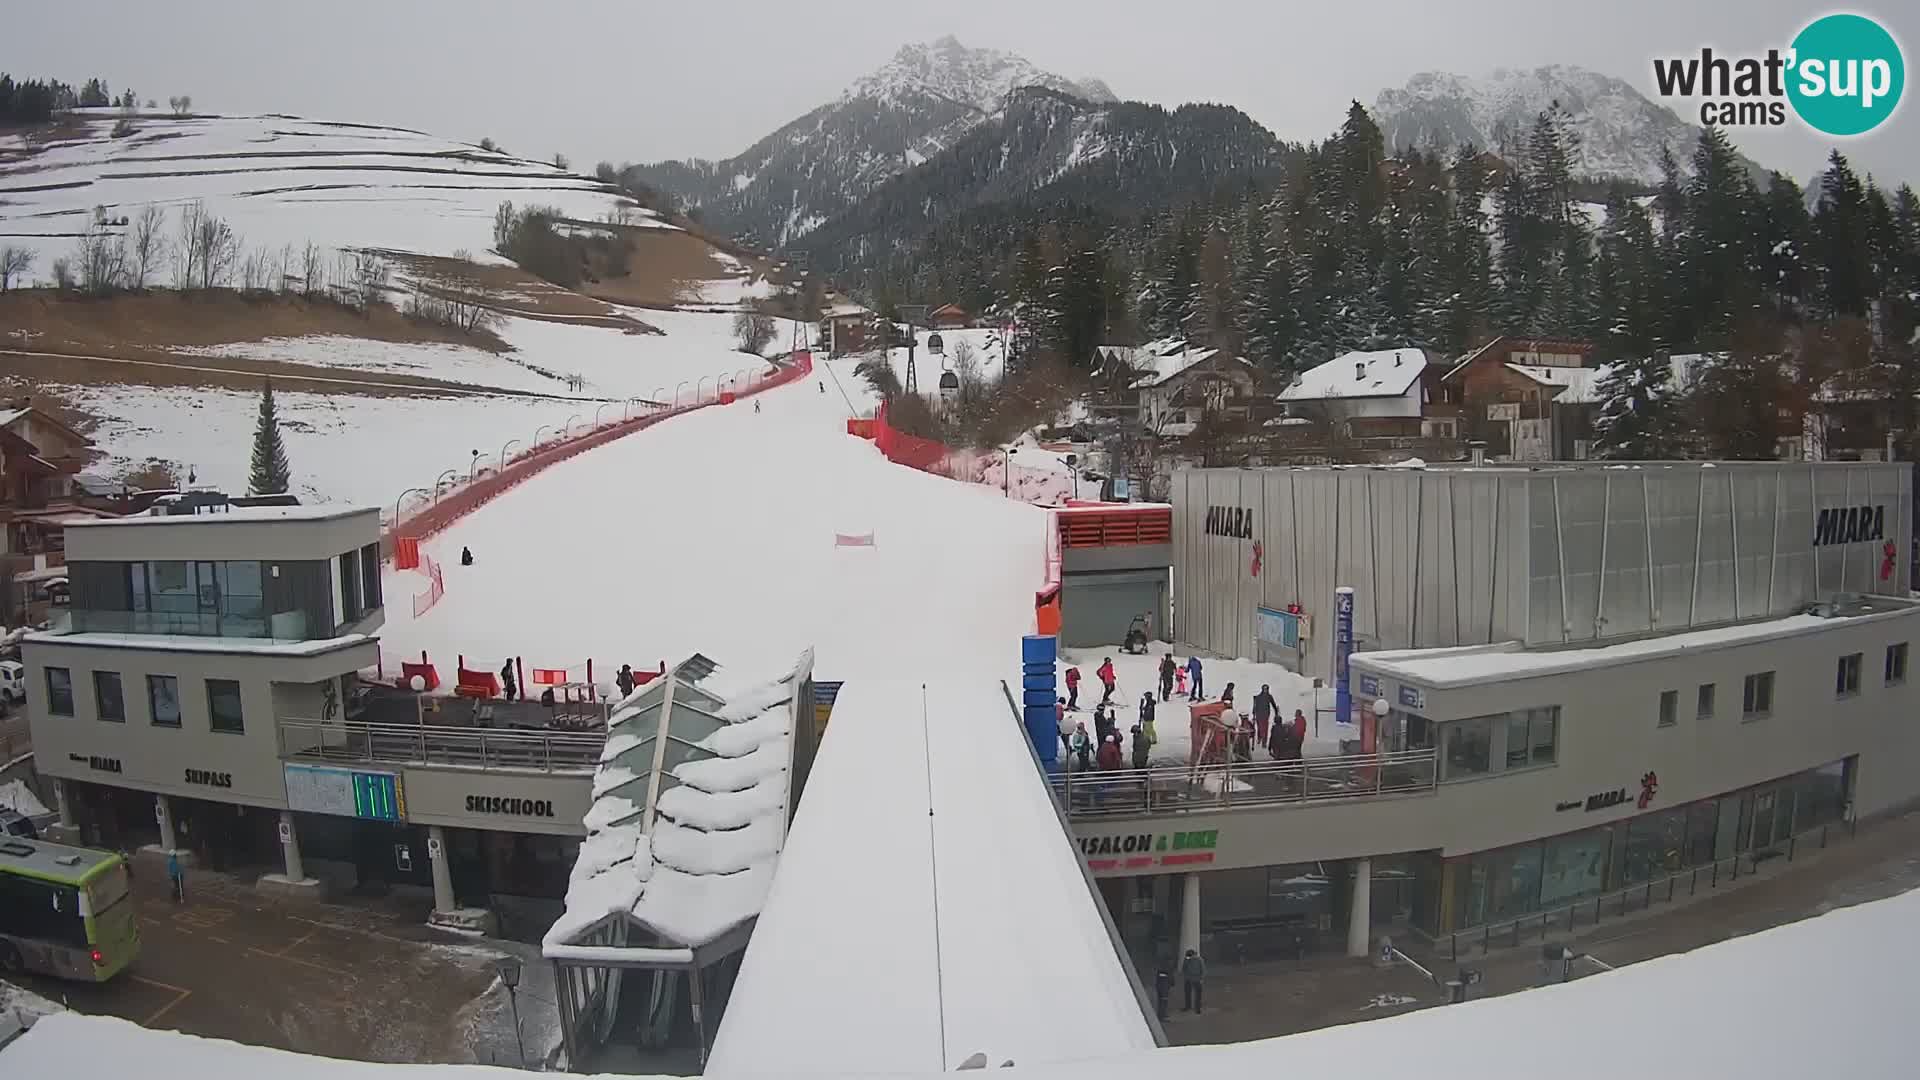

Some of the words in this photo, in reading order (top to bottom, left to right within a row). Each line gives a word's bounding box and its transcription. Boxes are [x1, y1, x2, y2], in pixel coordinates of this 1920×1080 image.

[1206, 506, 1253, 539] MIARA
[1813, 505, 1884, 546] MIARA
[184, 768, 232, 788] SKIPASS
[465, 795, 555, 817] SKISCHOOL
[1076, 834, 1153, 855] ISALON
